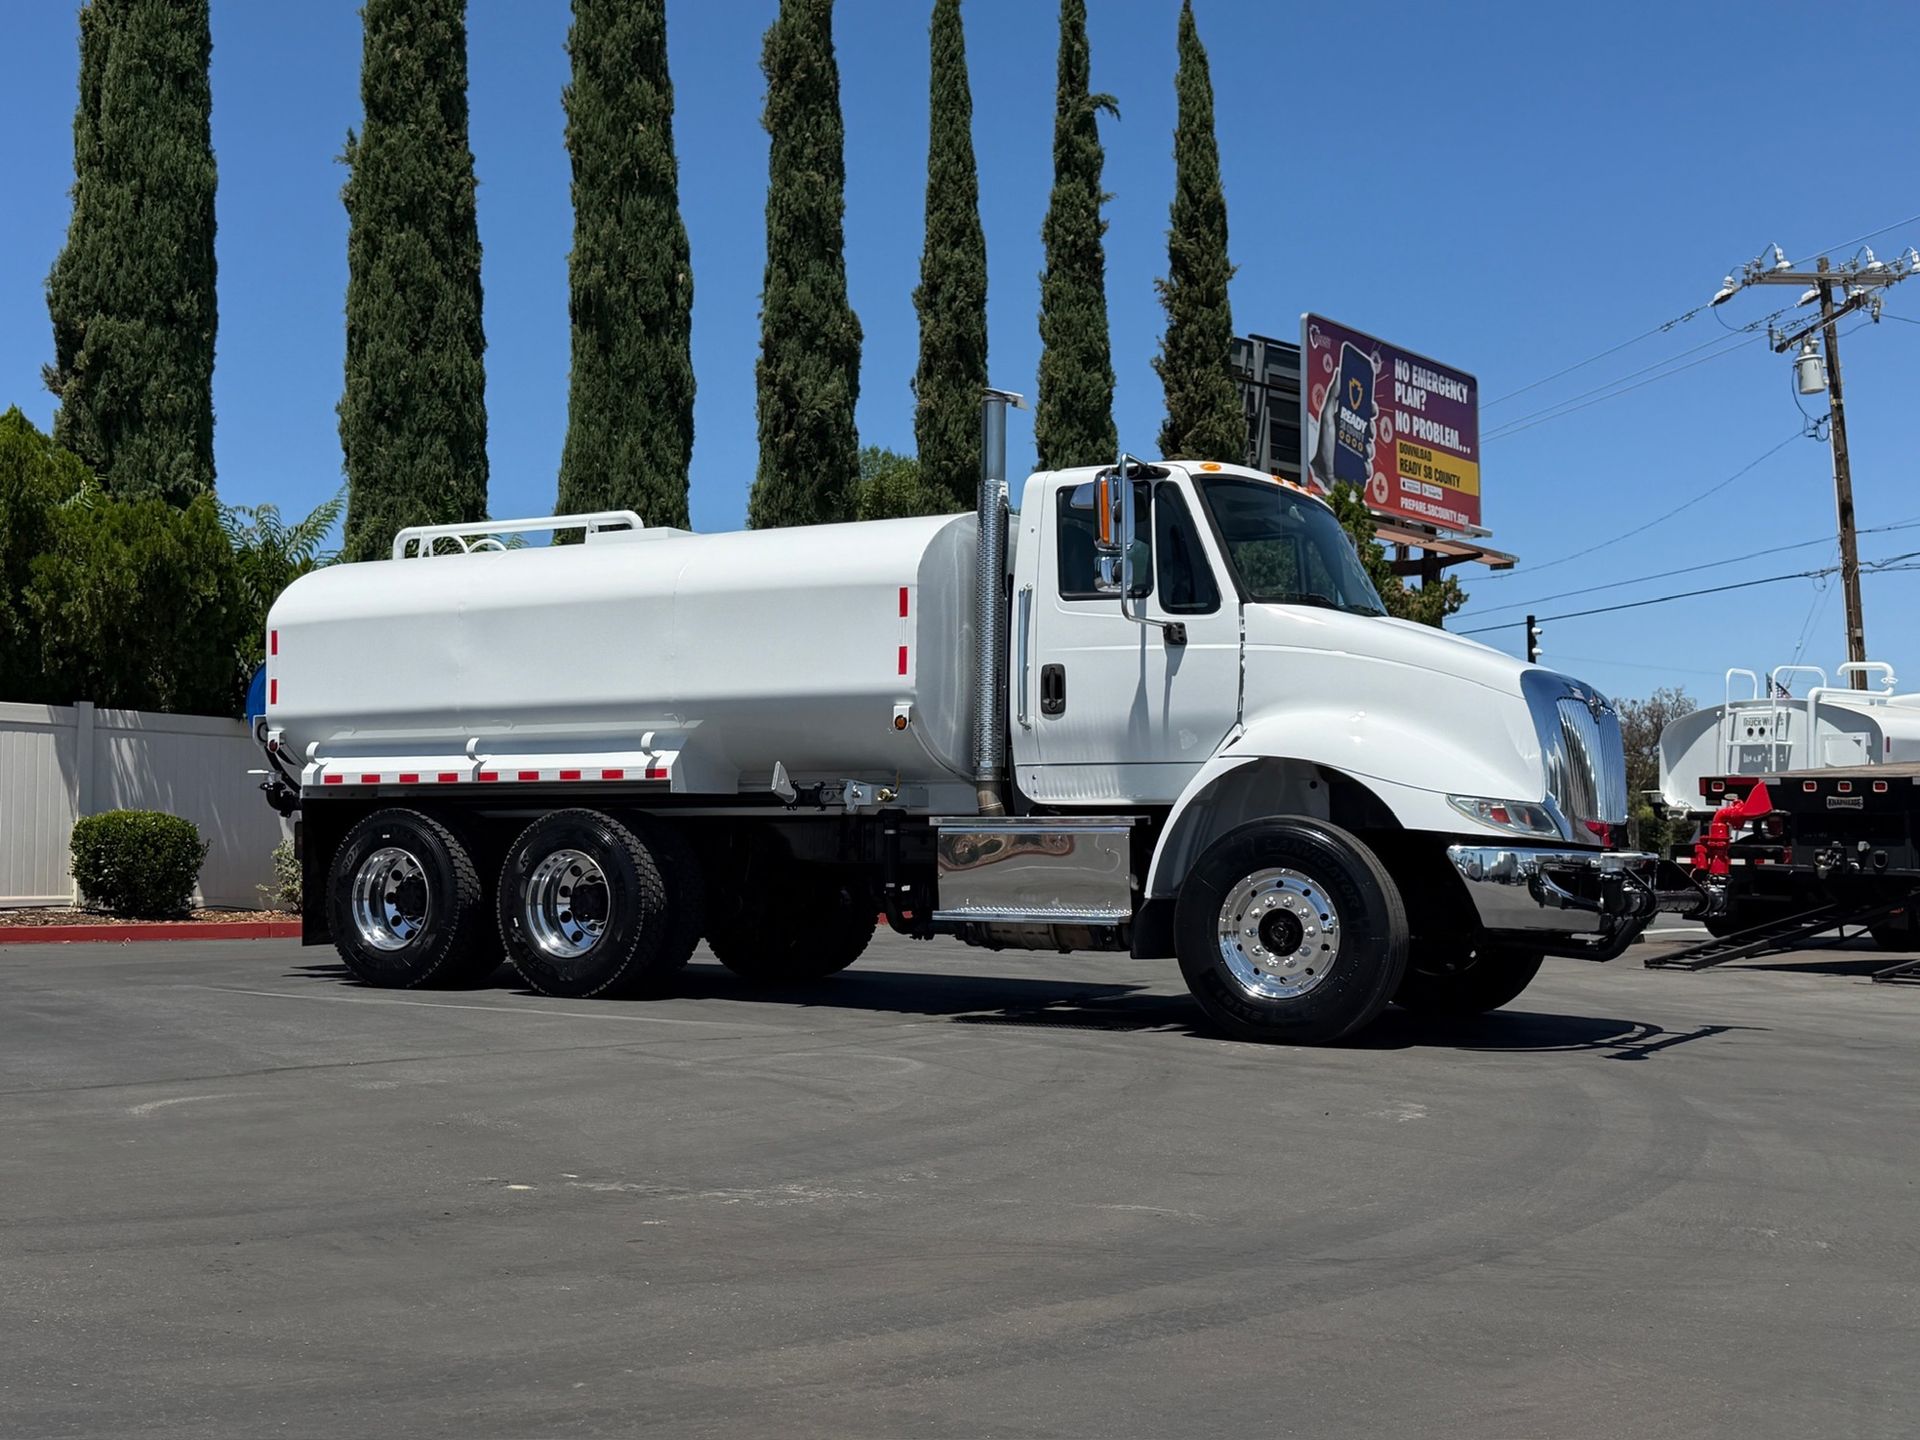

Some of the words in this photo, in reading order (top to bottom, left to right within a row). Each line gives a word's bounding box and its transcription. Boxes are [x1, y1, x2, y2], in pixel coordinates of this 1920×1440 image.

[1395, 358, 1410, 383] NO
[1412, 365, 1469, 404] EMERGENCY
[1395, 382, 1427, 411] PLAN?
[1340, 406, 1368, 434] READY
[1395, 409, 1410, 434] NO
[1412, 416, 1471, 454] PROBLEM...
[1399, 442, 1432, 462] DOWNLOAD
[1400, 458, 1422, 477] READY
[1424, 465, 1433, 480] SB
[1434, 468, 1461, 489] COUNTY
